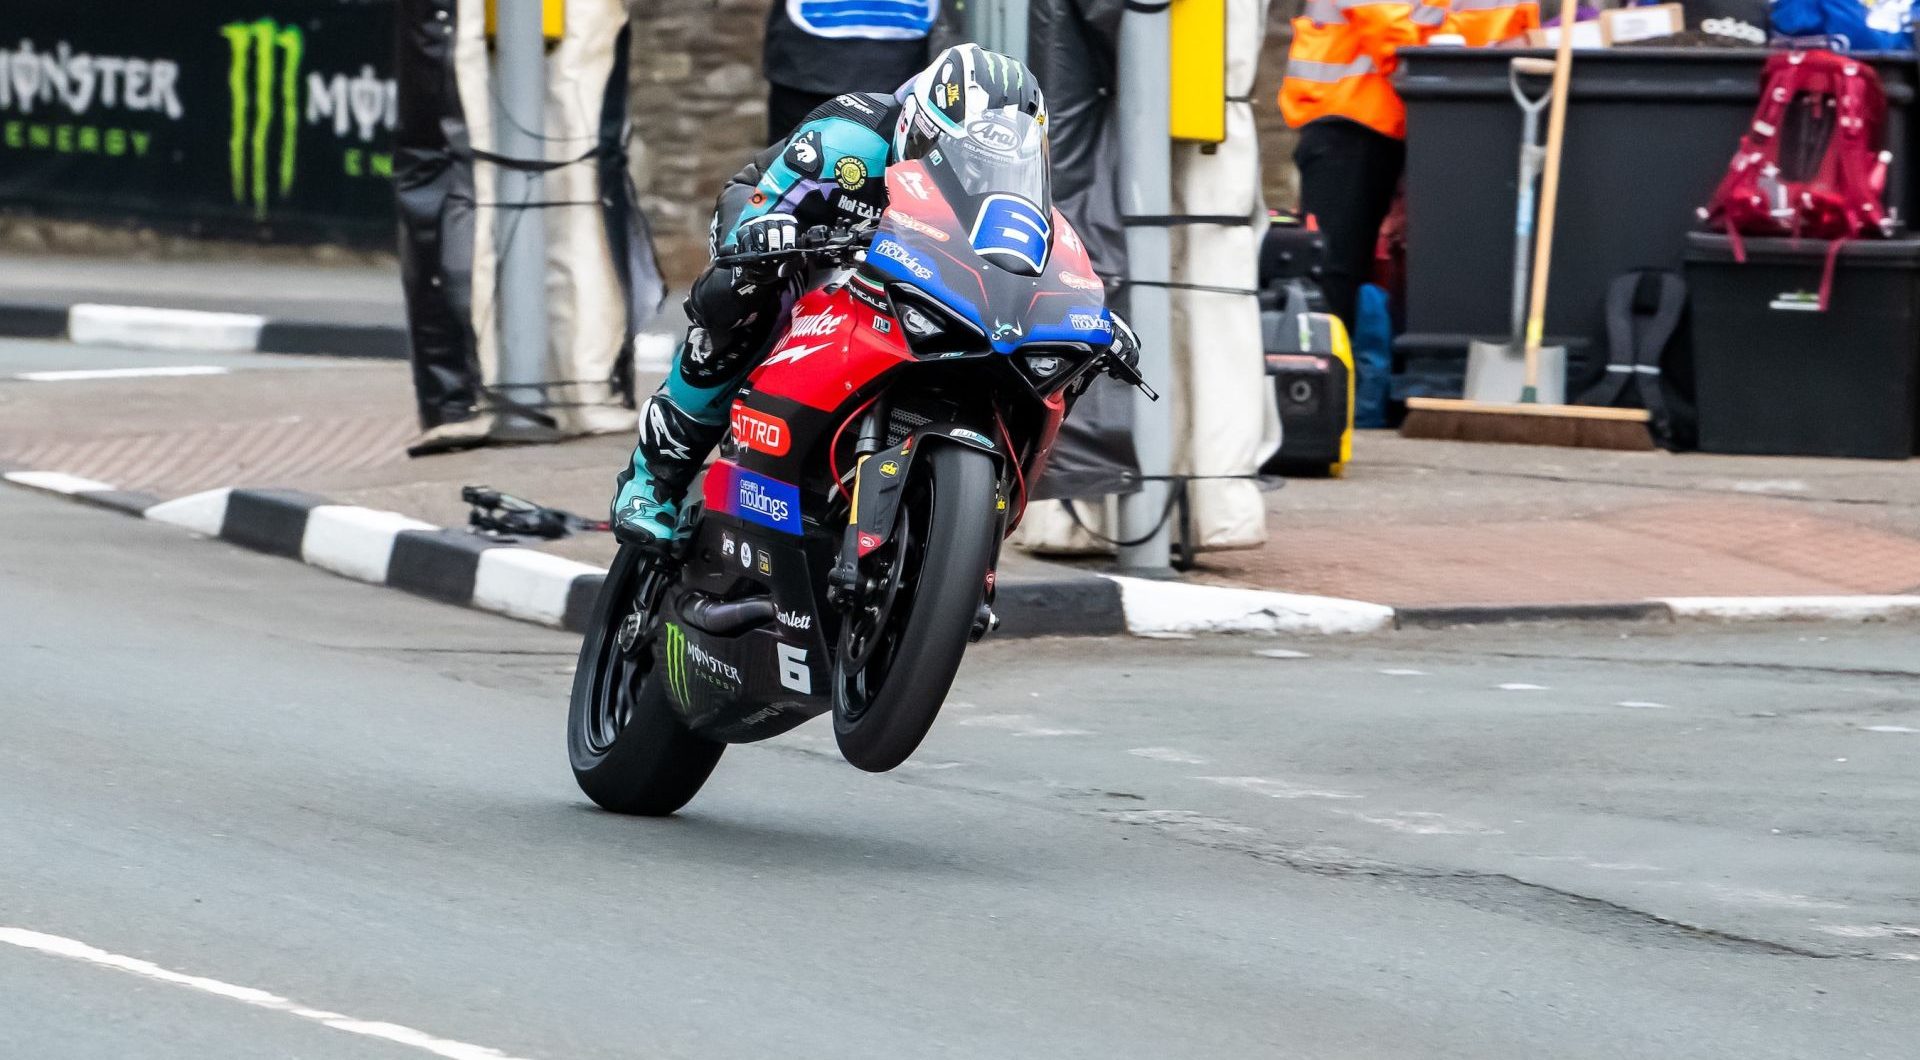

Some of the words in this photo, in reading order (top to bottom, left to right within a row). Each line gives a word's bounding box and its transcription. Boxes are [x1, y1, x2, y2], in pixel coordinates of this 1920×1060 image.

[0, 38, 184, 119] ONSTER
[5, 120, 151, 156] ENERGY
[971, 123, 1015, 147] Arai
[837, 157, 867, 177] AROUND
[838, 178, 865, 191] POUND
[740, 486, 789, 521] mouldings
[687, 641, 742, 685] MONSTER
[695, 668, 736, 693] ENERGY
[777, 642, 812, 695] 6
